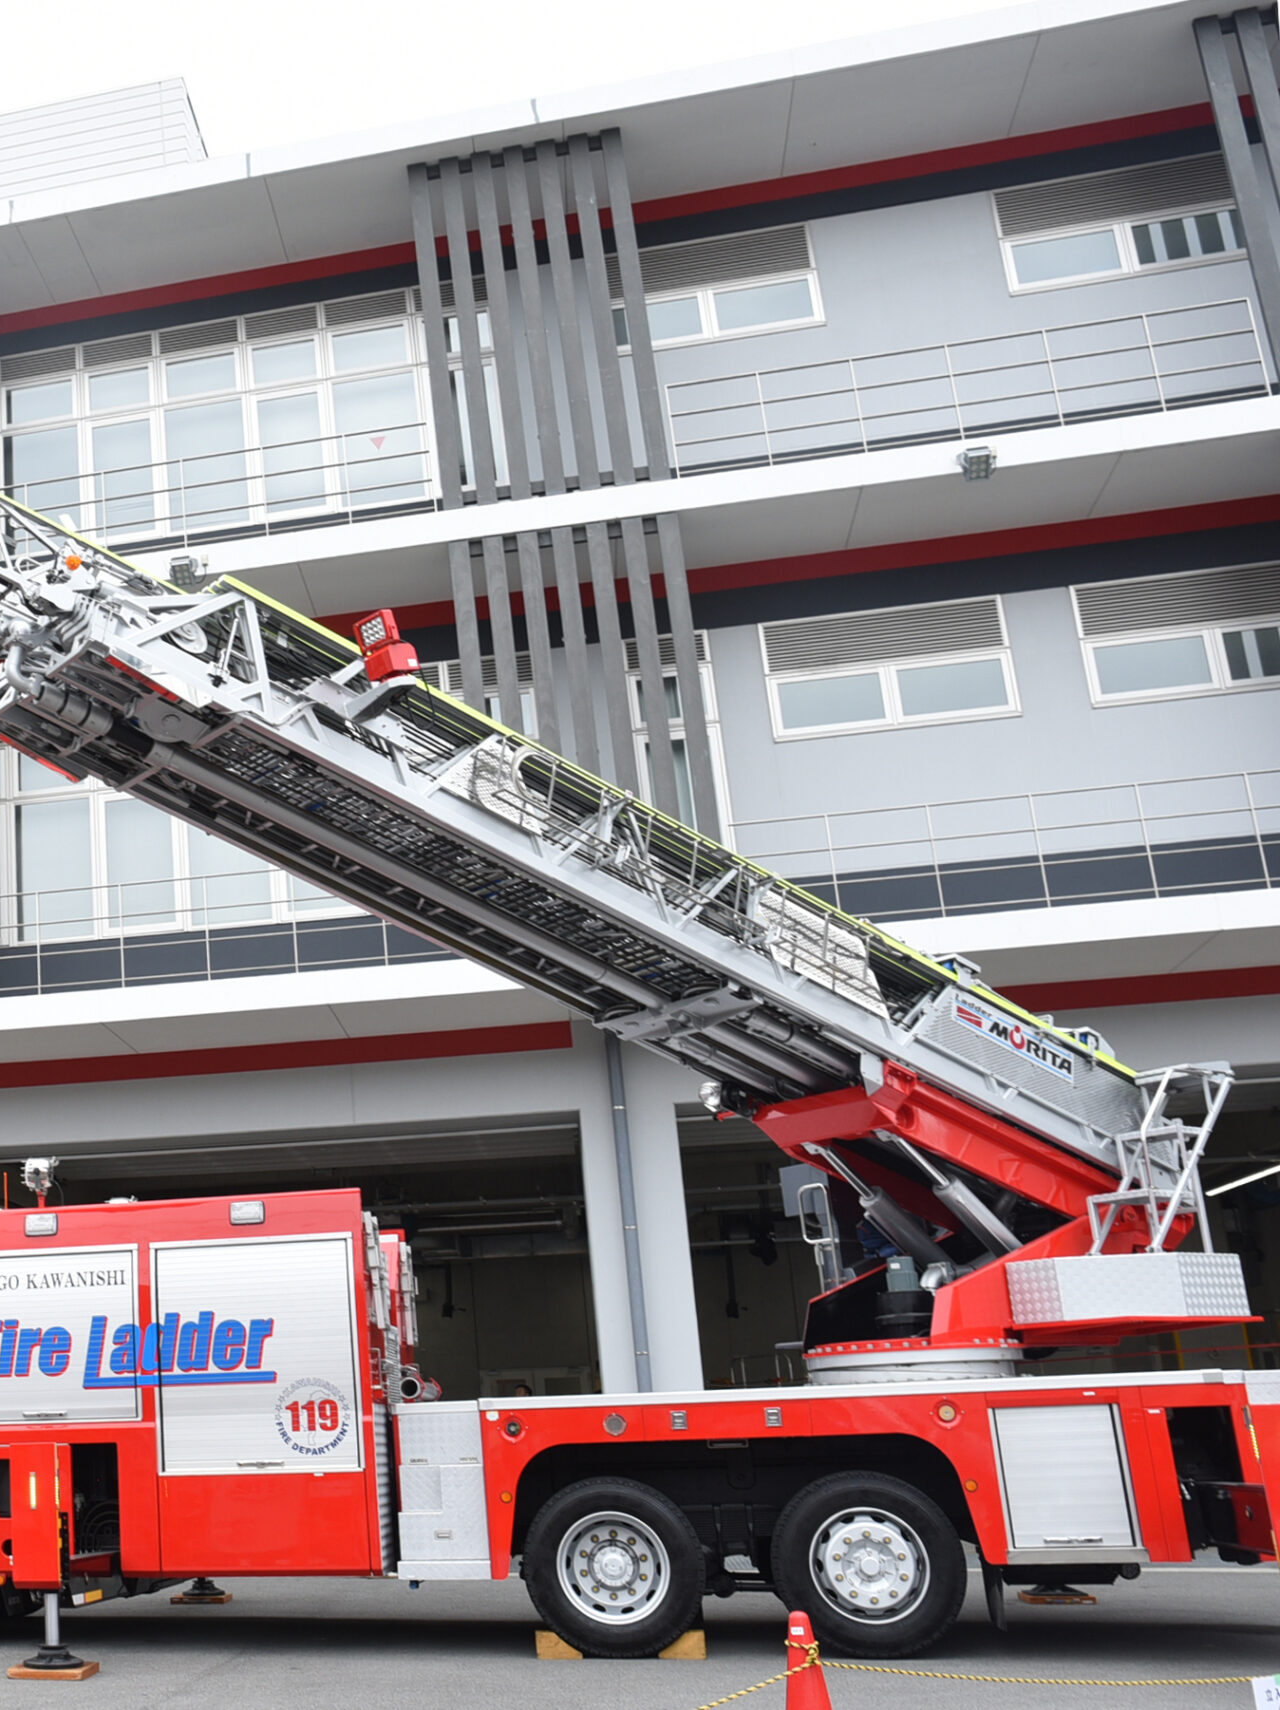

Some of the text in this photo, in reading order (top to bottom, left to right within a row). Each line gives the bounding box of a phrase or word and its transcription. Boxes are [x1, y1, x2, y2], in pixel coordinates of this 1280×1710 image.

[955, 993, 992, 1018] Ladder
[990, 1022, 1071, 1074] MORITA
[26, 1269, 127, 1290] KAWANISHI
[83, 1310, 277, 1389] Ladder
[285, 1399, 339, 1432] 119
[276, 1422, 349, 1455] FIRE DEPARTMENT
